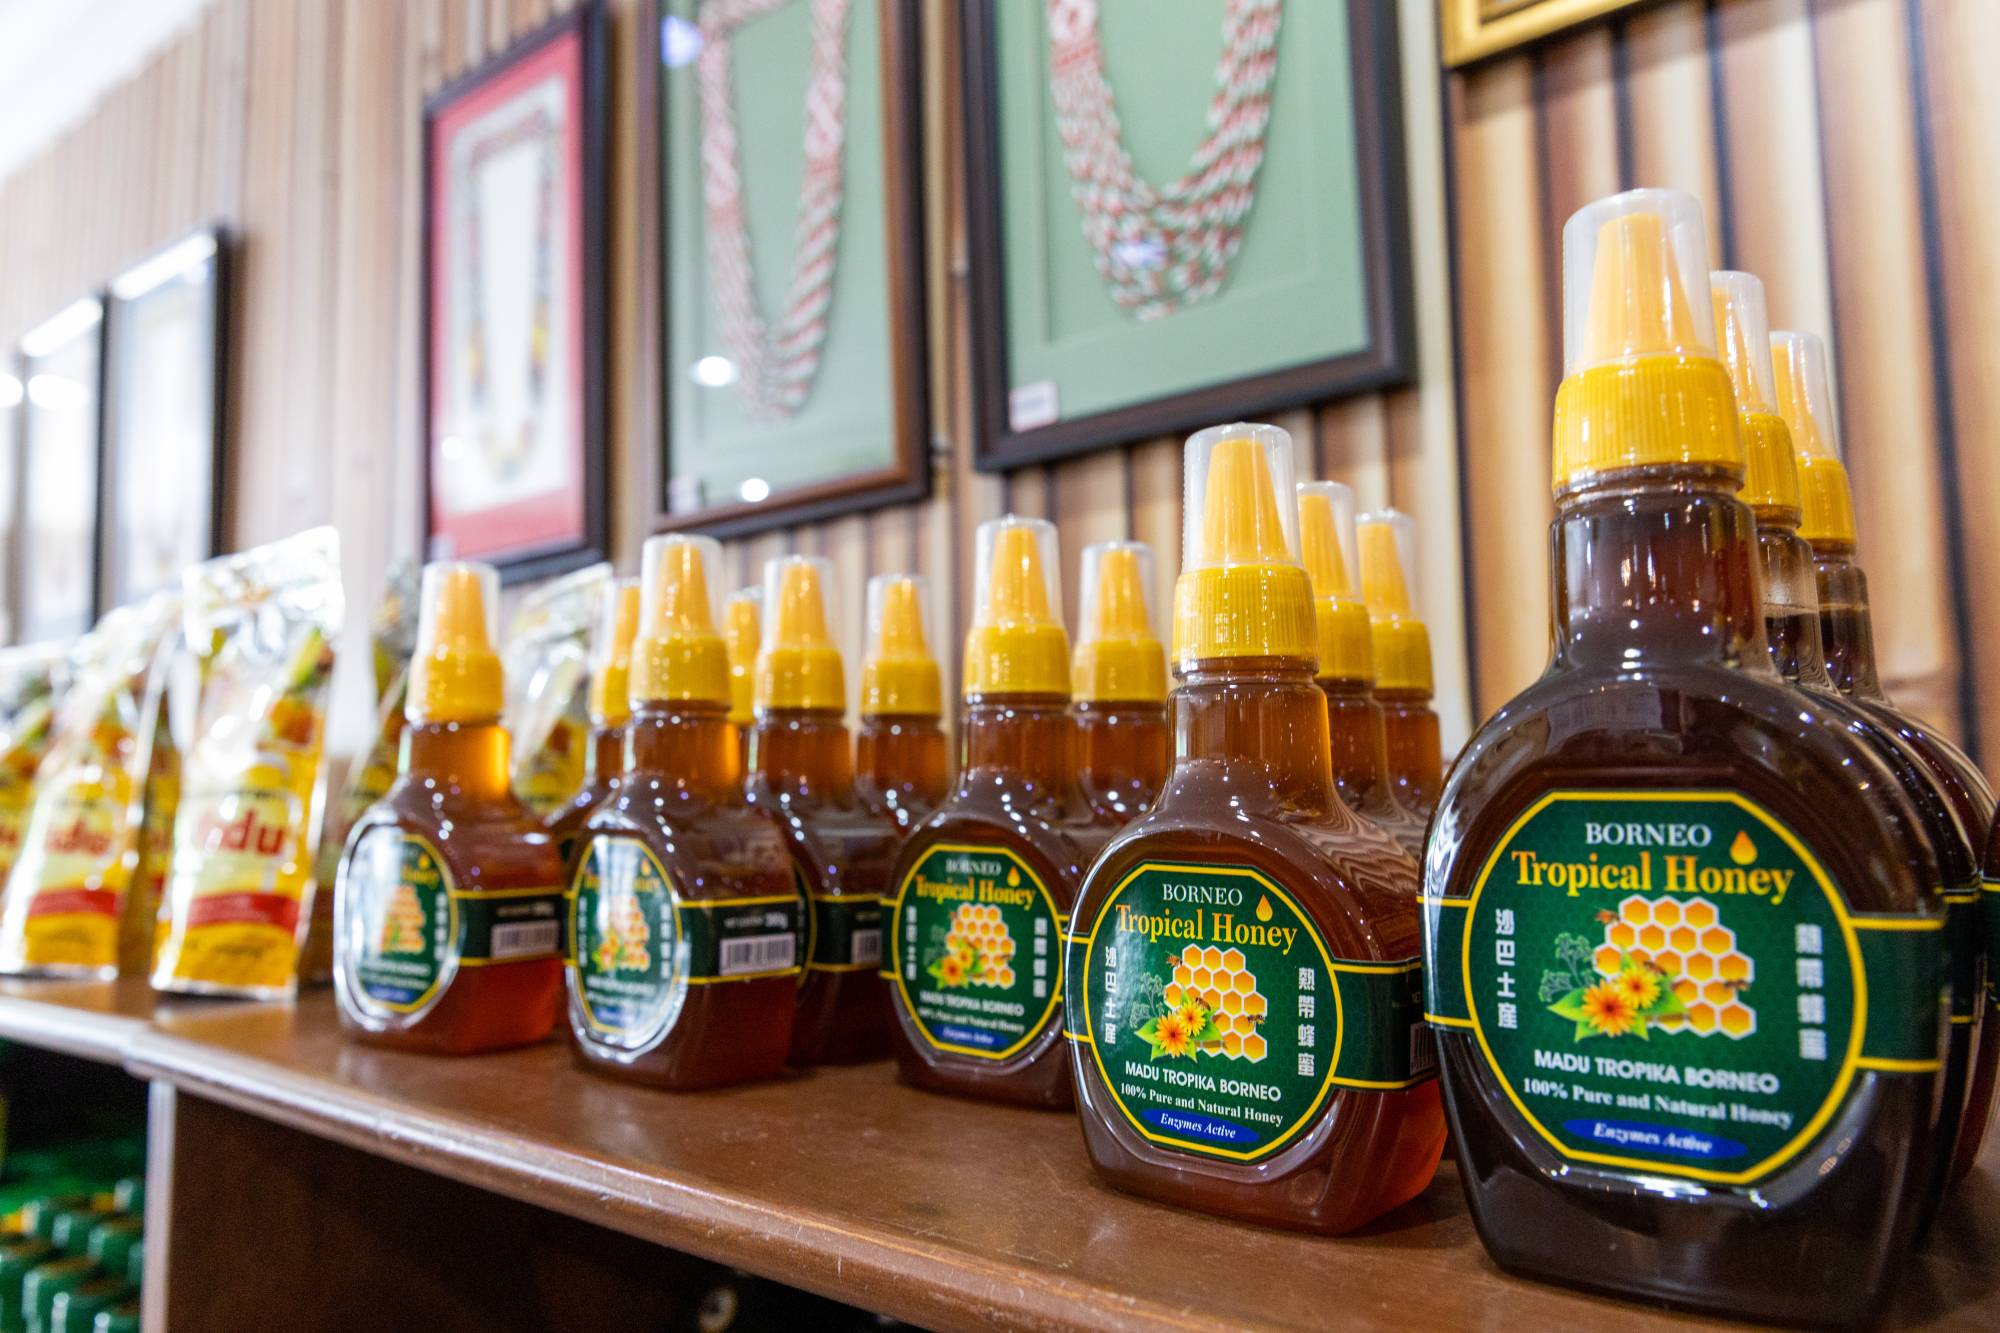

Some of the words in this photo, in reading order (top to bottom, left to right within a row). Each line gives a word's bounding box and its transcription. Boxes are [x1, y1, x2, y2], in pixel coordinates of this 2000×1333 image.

[1585, 822, 1712, 847] BORNEO
[916, 874, 975, 905] Tropical
[979, 880, 1036, 911] Honey
[1162, 883, 1243, 907] BORNEO
[1511, 850, 1652, 897] Tropical
[1663, 855, 1795, 905] Honey
[1115, 903, 1204, 944] Tropical
[1211, 912, 1298, 956] Honey
[1125, 1060, 1159, 1081] MADU
[1162, 1068, 1216, 1092] TROPIKA
[1219, 1078, 1282, 1102] BORNEO
[1534, 1049, 1590, 1074] MADU
[1595, 1057, 1680, 1084] TROPIKA
[1684, 1067, 1780, 1094] BORNEO
[1120, 1082, 1147, 1100] 100%
[1149, 1089, 1172, 1105] Pure
[1175, 1096, 1195, 1110] and
[1197, 1099, 1241, 1118] Natural
[1244, 1106, 1284, 1128] Honey
[1523, 1077, 1568, 1099] 100%
[1572, 1085, 1613, 1106] Pure
[1616, 1091, 1650, 1110] and
[1654, 1095, 1726, 1121] Natural
[1730, 1102, 1794, 1131] Honey
[1160, 1113, 1202, 1132] Enzymes
[1203, 1123, 1236, 1139] Active
[1593, 1122, 1660, 1146] Enzymes
[1663, 1129, 1712, 1153] Active
